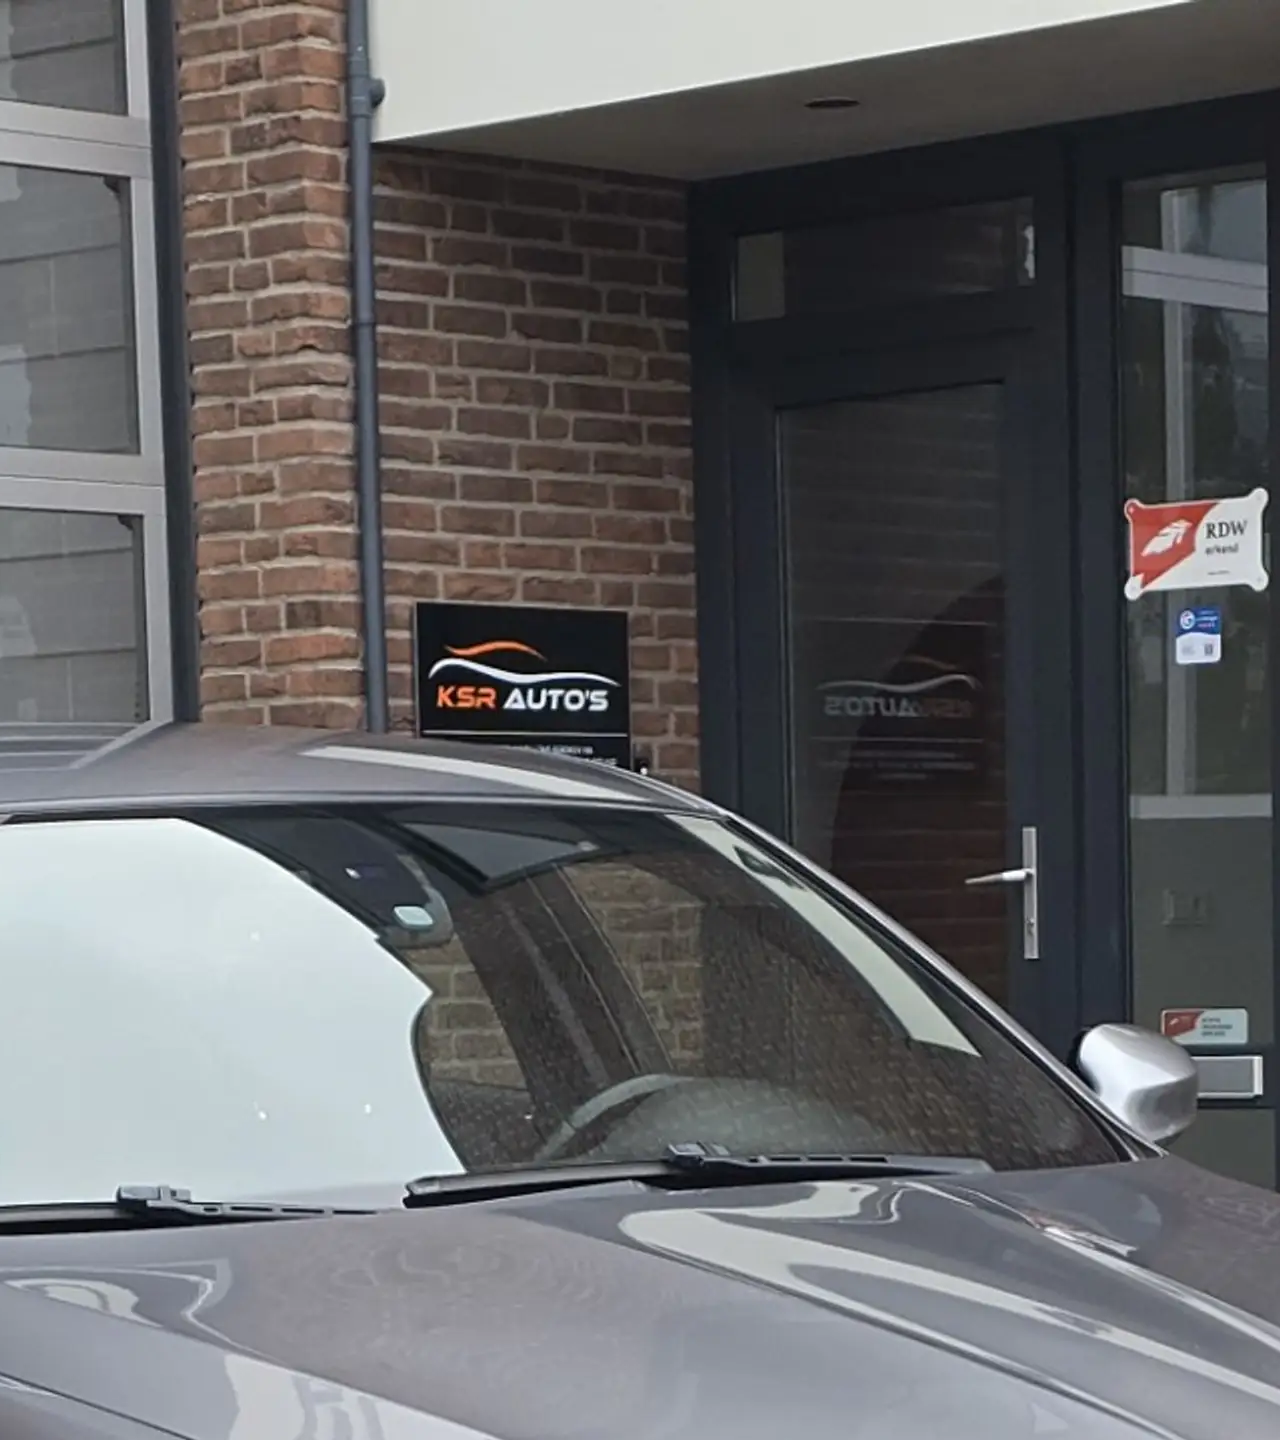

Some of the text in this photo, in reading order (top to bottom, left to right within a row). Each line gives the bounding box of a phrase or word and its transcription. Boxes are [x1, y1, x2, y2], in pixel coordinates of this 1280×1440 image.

[1205, 520, 1248, 539] RDW
[436, 685, 609, 711] KSR AUTO'S
